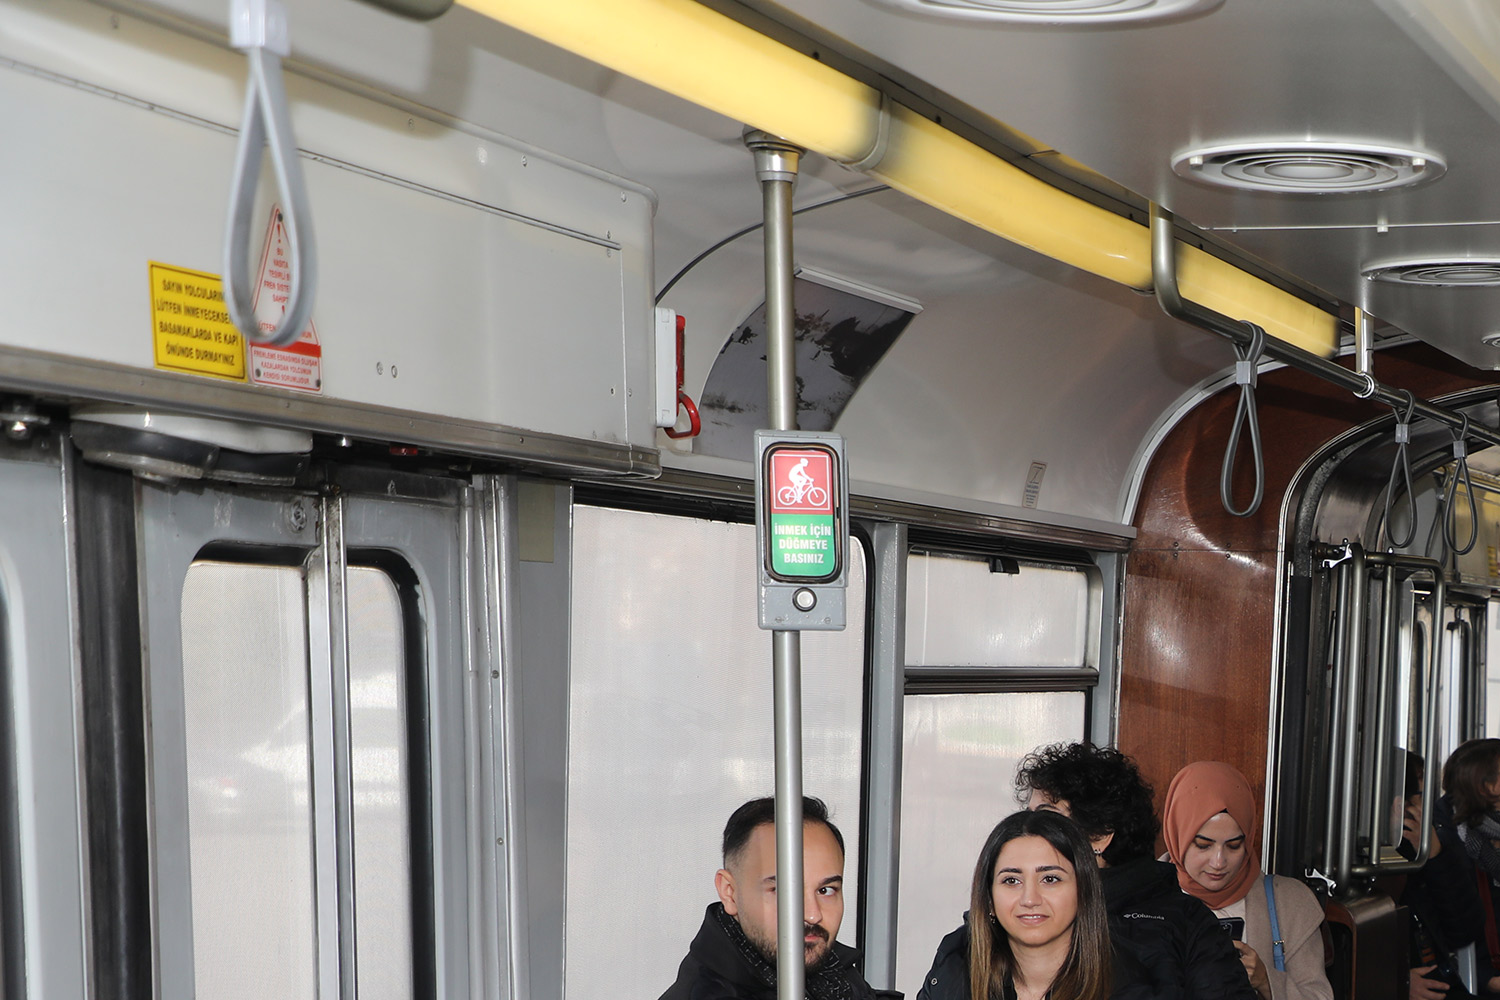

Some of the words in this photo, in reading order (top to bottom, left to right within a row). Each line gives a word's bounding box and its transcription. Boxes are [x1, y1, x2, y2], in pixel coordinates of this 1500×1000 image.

[214, 331, 222, 344] VE
[774, 522, 808, 536] İNMEK
[810, 523, 832, 539] İÇİN
[779, 537, 828, 550] DÜĞMEYE
[784, 553, 825, 564] BASINIZ
